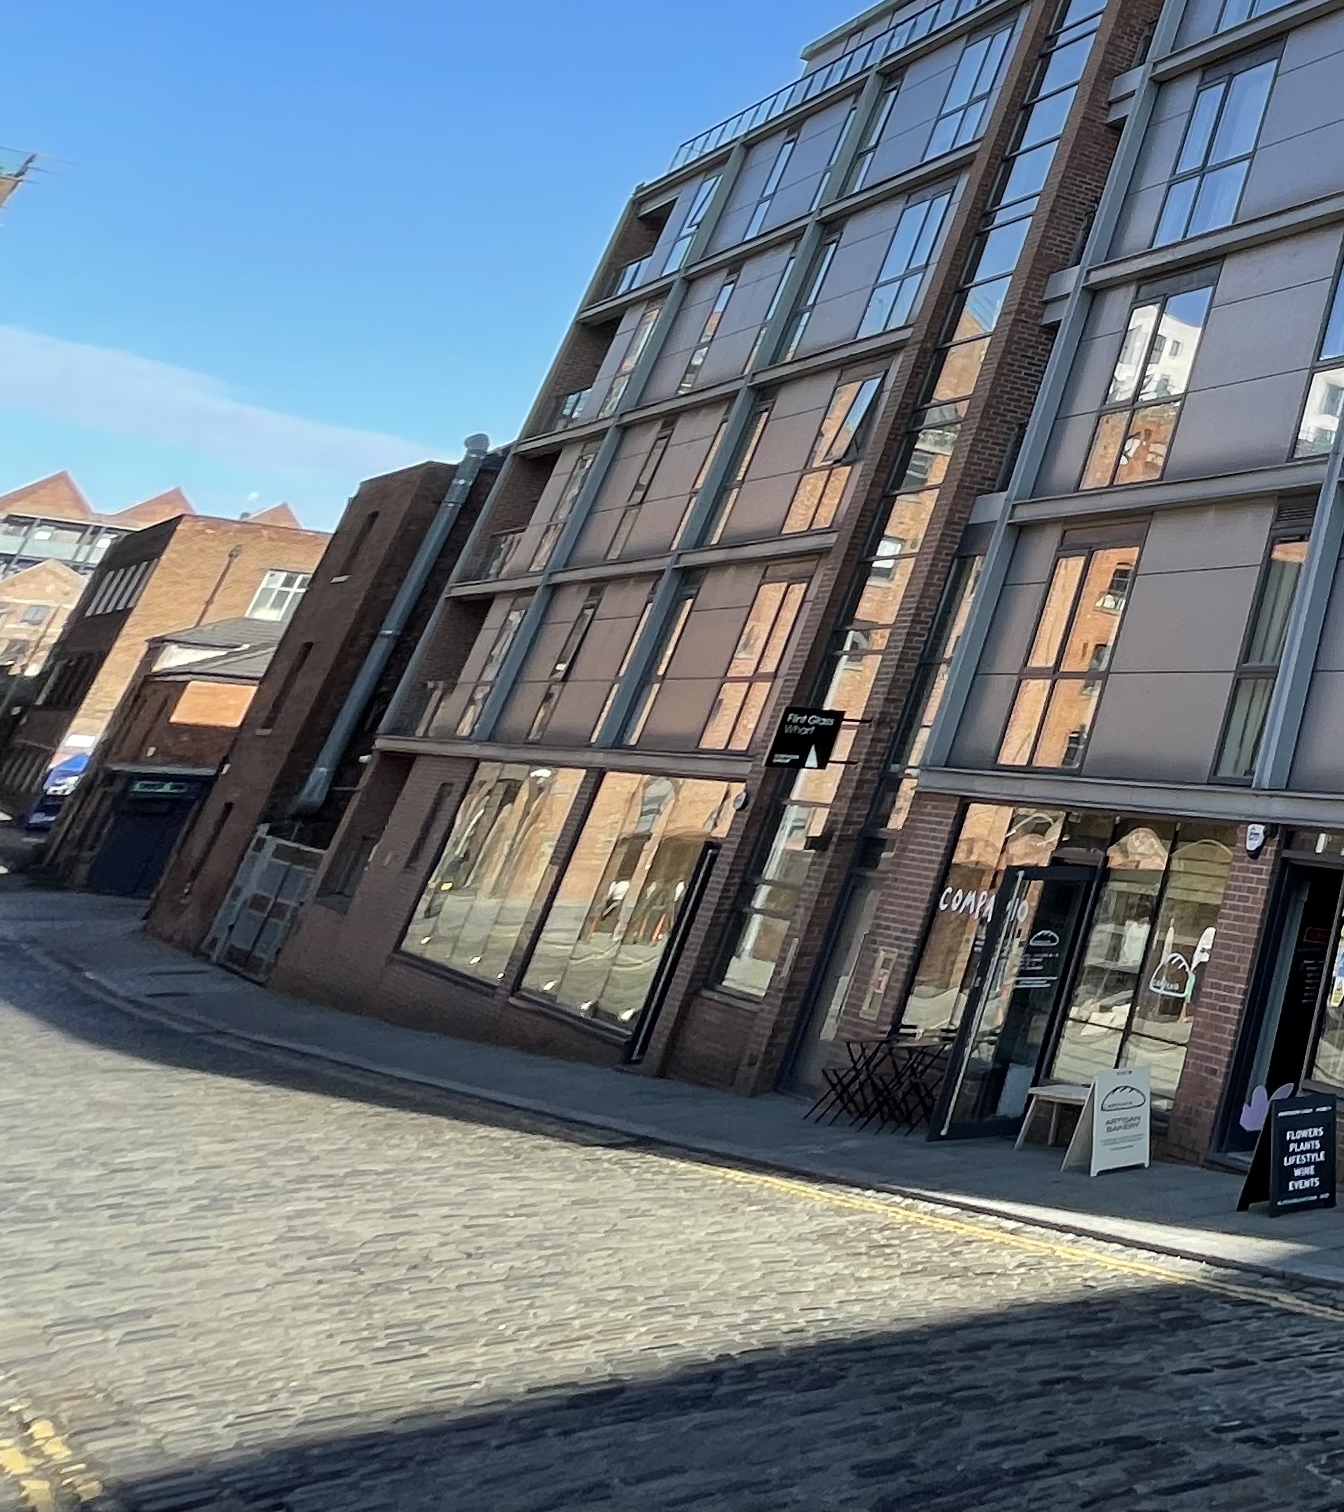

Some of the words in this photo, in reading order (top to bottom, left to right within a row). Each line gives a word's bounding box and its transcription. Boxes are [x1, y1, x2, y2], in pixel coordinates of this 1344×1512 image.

[808, 715, 834, 726] Glass
[1289, 1140, 1320, 1153] PLANTS
[1283, 1151, 1326, 1167] LIFESTYLE
[1288, 1177, 1320, 1191] EVENTS
